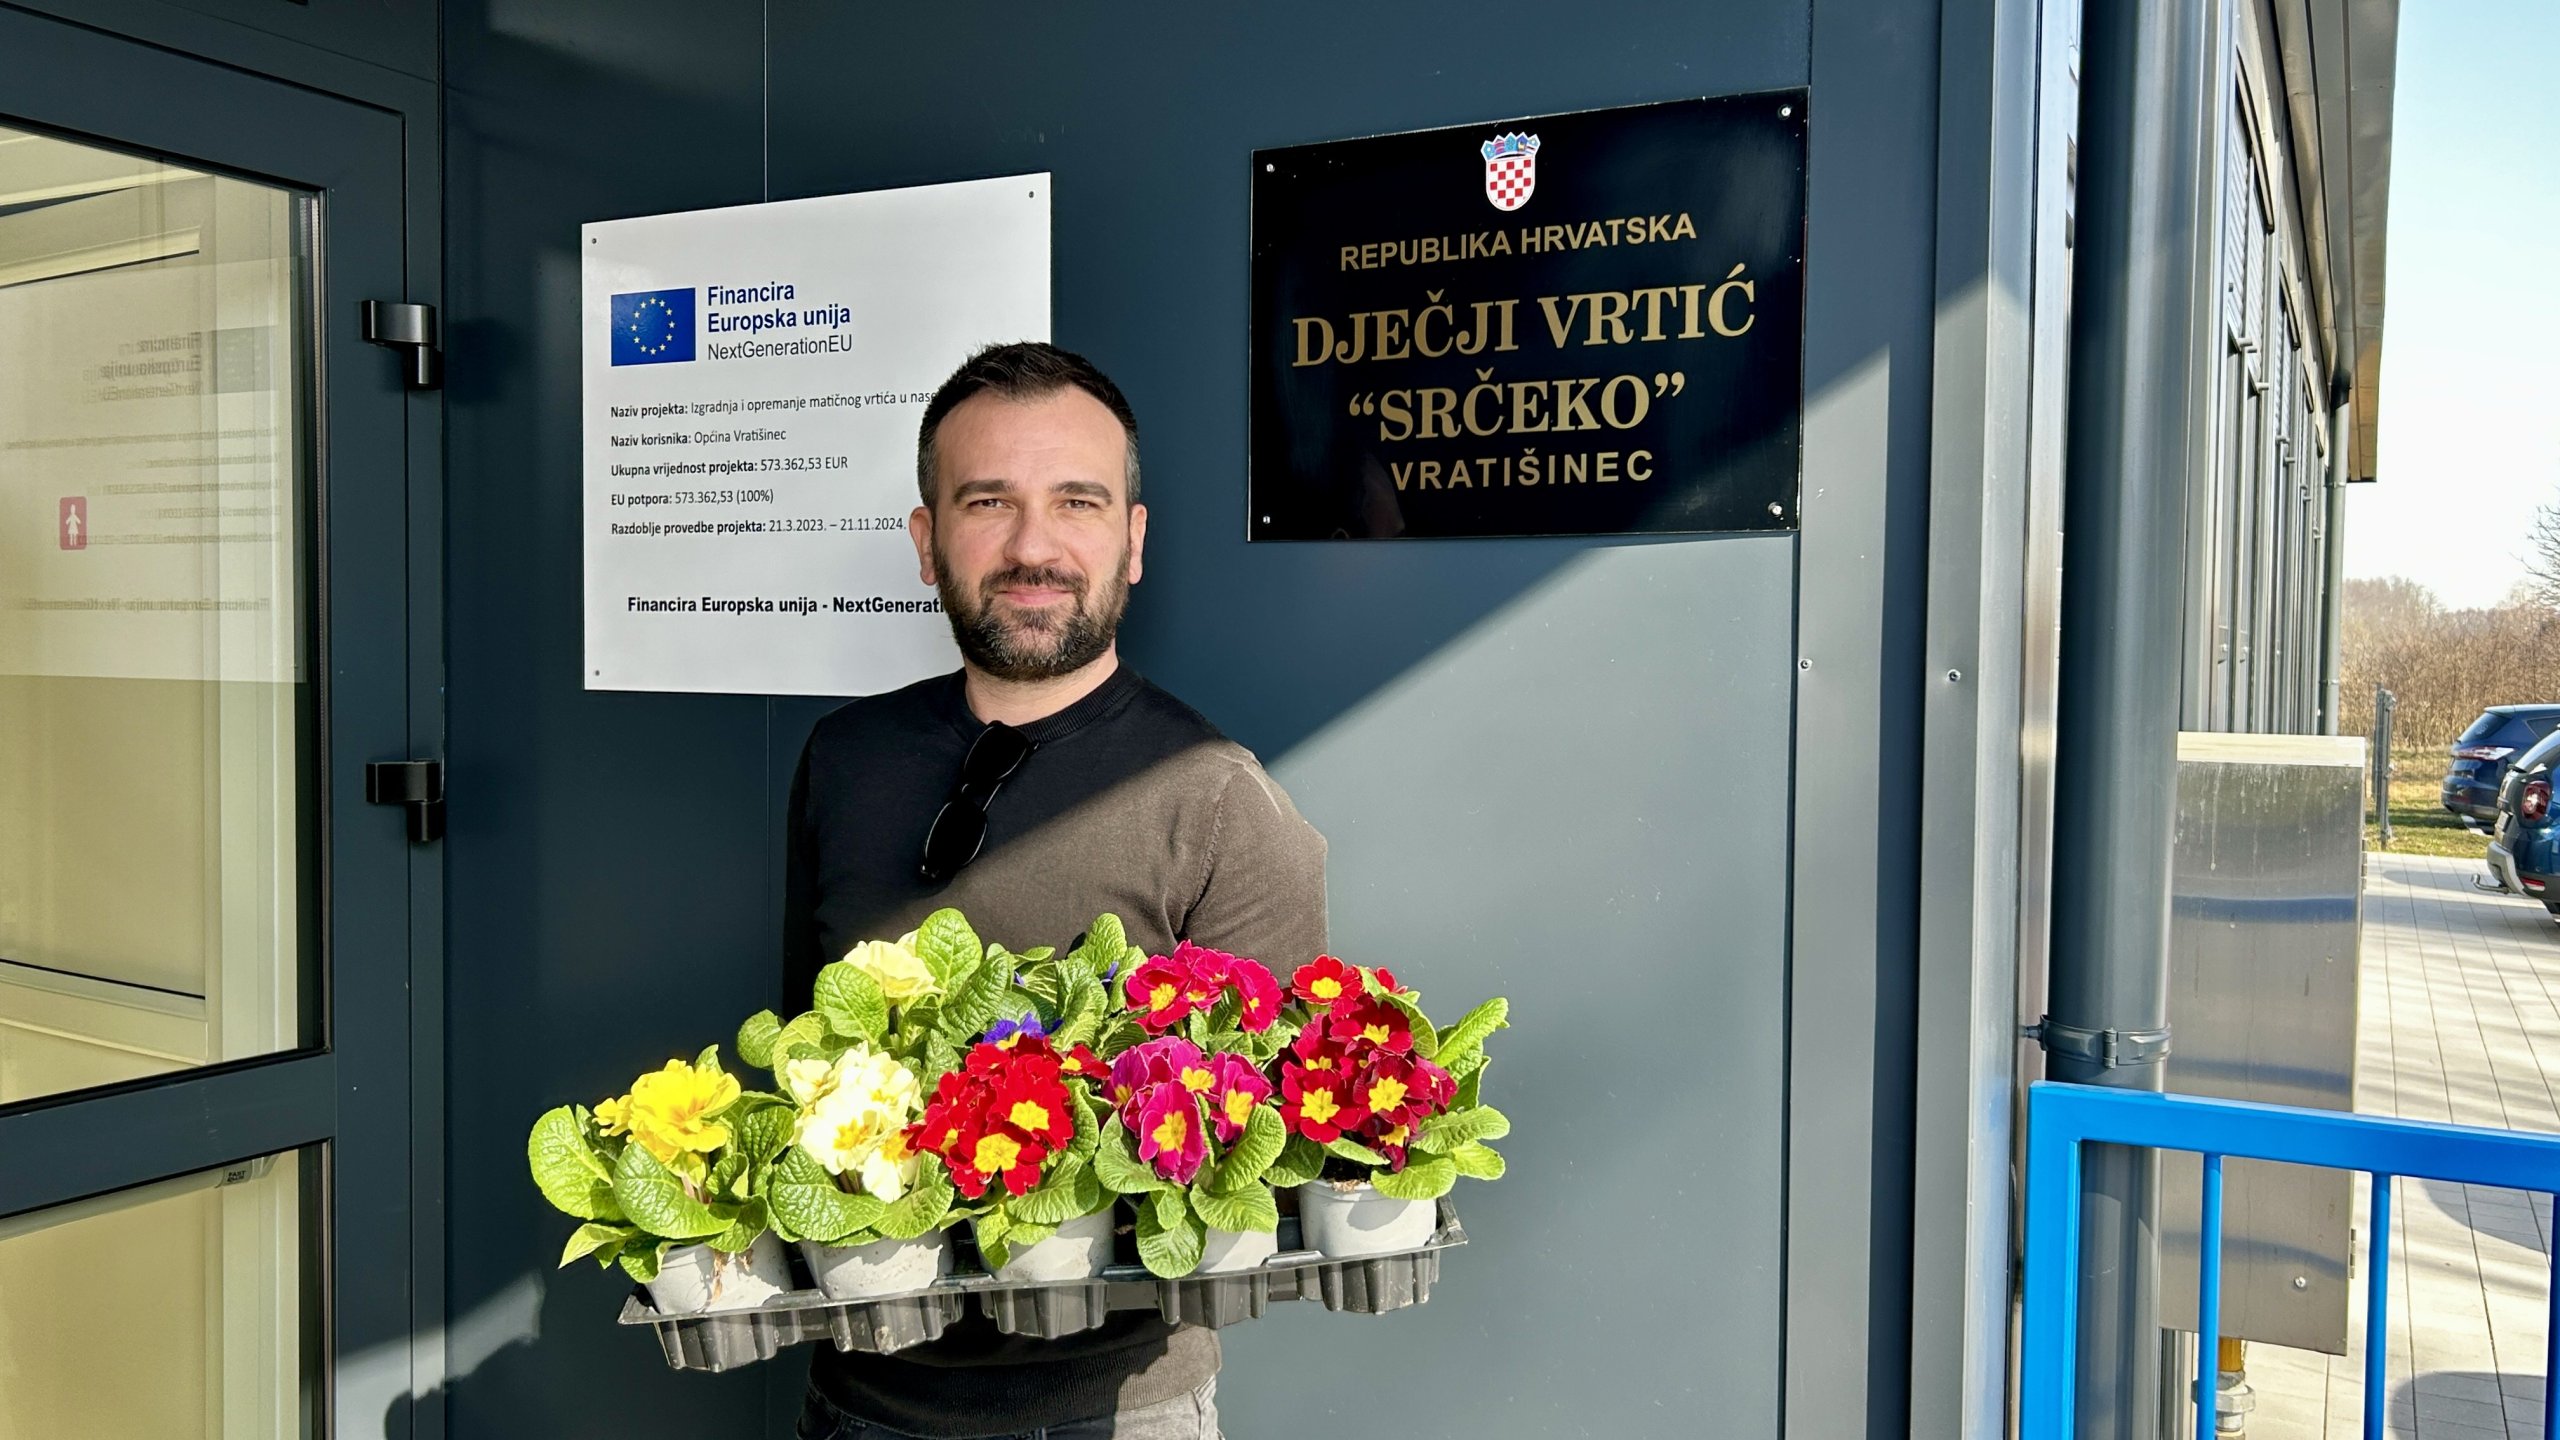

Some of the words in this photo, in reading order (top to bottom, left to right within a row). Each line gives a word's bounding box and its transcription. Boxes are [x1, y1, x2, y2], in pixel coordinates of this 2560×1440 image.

[1340, 230, 1513, 272] REPUBLIKA
[1521, 212, 1697, 254] HRVATSKA
[707, 280, 795, 307] Financira
[707, 307, 798, 336] Europska
[803, 302, 851, 330] unija
[1291, 288, 1520, 367] DJEČJI
[1536, 262, 1755, 349] VRTIĆ
[707, 333, 853, 361] NextGenerationEU
[610, 404, 639, 418] Naziv
[640, 402, 688, 420] projekta:
[690, 400, 739, 417] Izgradnja
[740, 399, 745, 412] i
[747, 396, 807, 413] opremanje
[809, 393, 862, 409] matičnog
[863, 390, 897, 406] vrtića
[899, 393, 907, 404] u
[610, 434, 639, 448] Naziv
[641, 430, 692, 446] korisnika:
[693, 429, 731, 446] Općina
[733, 426, 788, 442] Vratišinec
[610, 463, 651, 479] Ukupna
[652, 461, 707, 478] vrijednost
[708, 459, 758, 477] projekta:
[759, 456, 822, 473] 573.362,53
[825, 456, 848, 470] EUR
[1390, 447, 1653, 491] VRATIŠINEC
[611, 493, 625, 506] EU
[627, 493, 673, 509] potpora:
[674, 490, 734, 506] 573.362,53
[736, 488, 774, 505] (100%)
[611, 521, 662, 537] Razdoblje
[663, 520, 715, 537] provedbe
[716, 519, 767, 536] projekta:
[768, 518, 827, 533] 21.3.2023.
[839, 517, 907, 531] 21.11.2024.
[627, 596, 697, 613] Financira
[701, 596, 774, 617] Europska
[778, 596, 818, 617] unija
